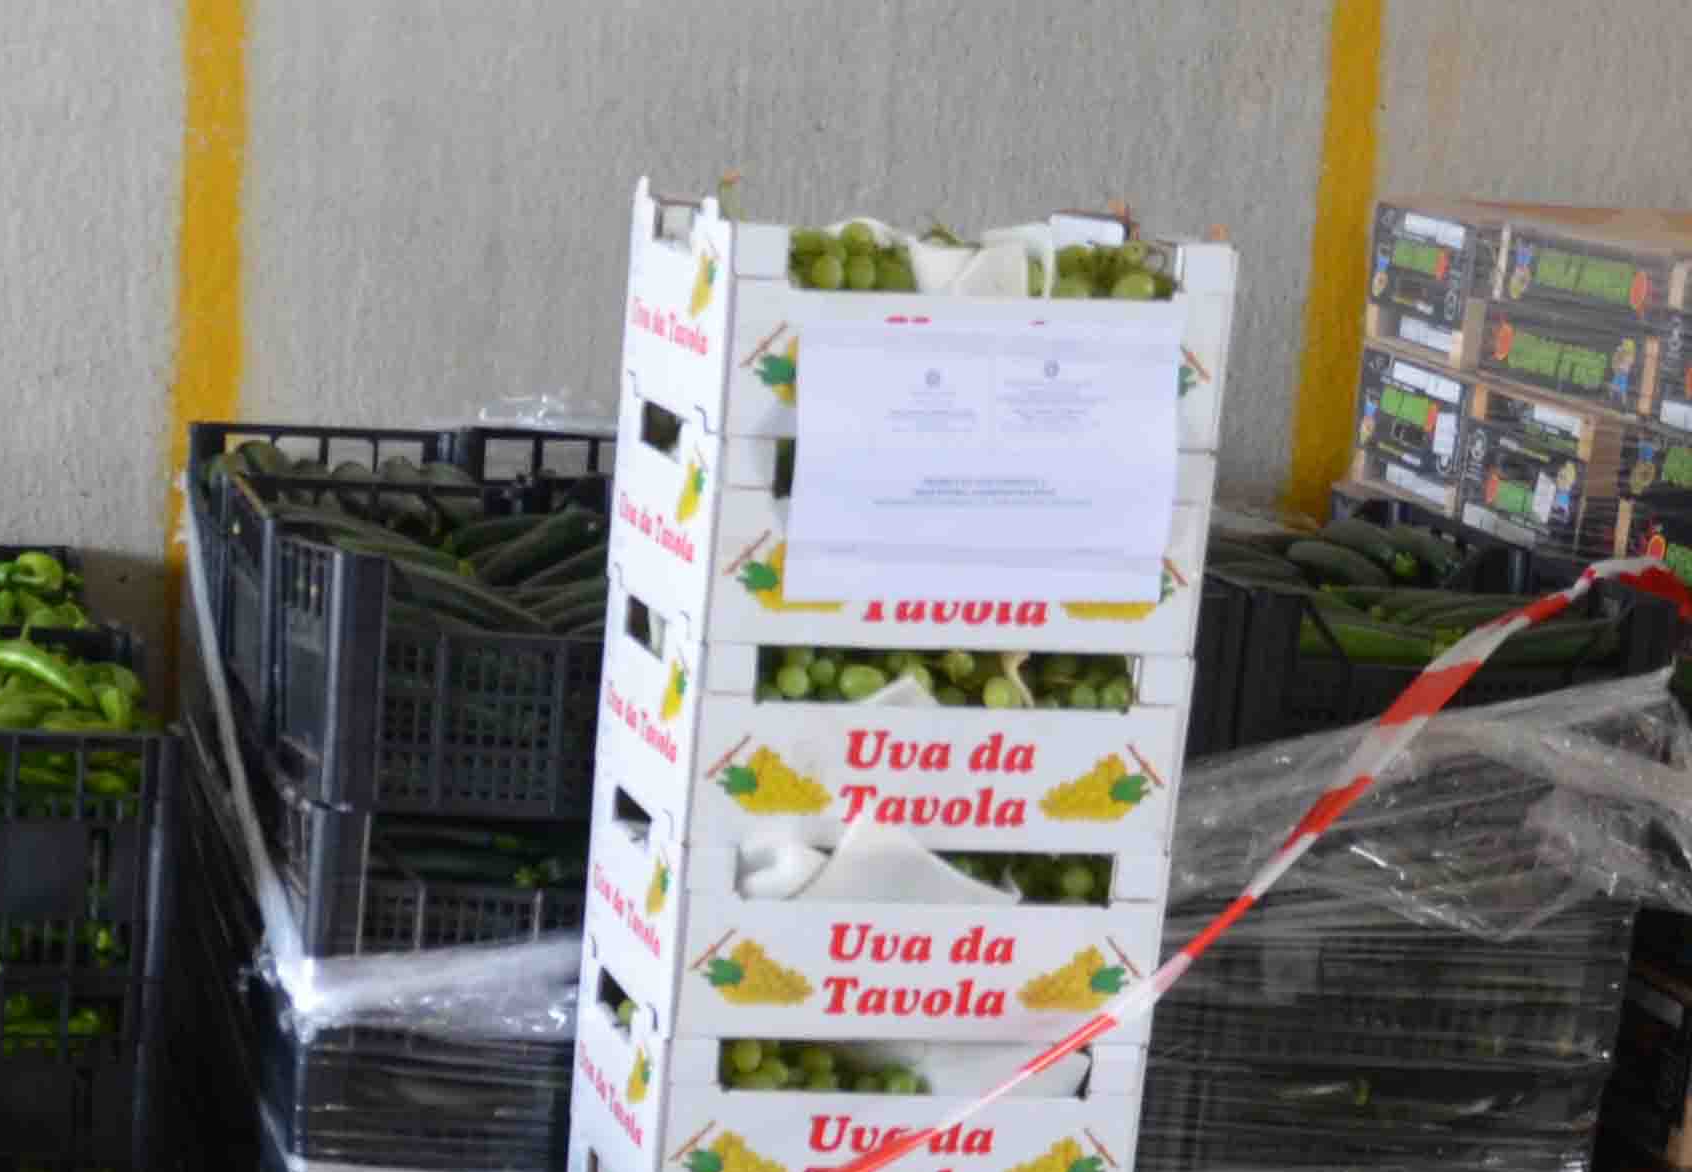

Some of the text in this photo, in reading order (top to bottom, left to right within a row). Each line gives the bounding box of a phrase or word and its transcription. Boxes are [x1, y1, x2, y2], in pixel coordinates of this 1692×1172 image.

[844, 729, 1037, 773] Uva da
[840, 785, 1028, 828] Tavola
[827, 923, 1016, 965] Uva da
[823, 975, 1007, 1018] Tavola
